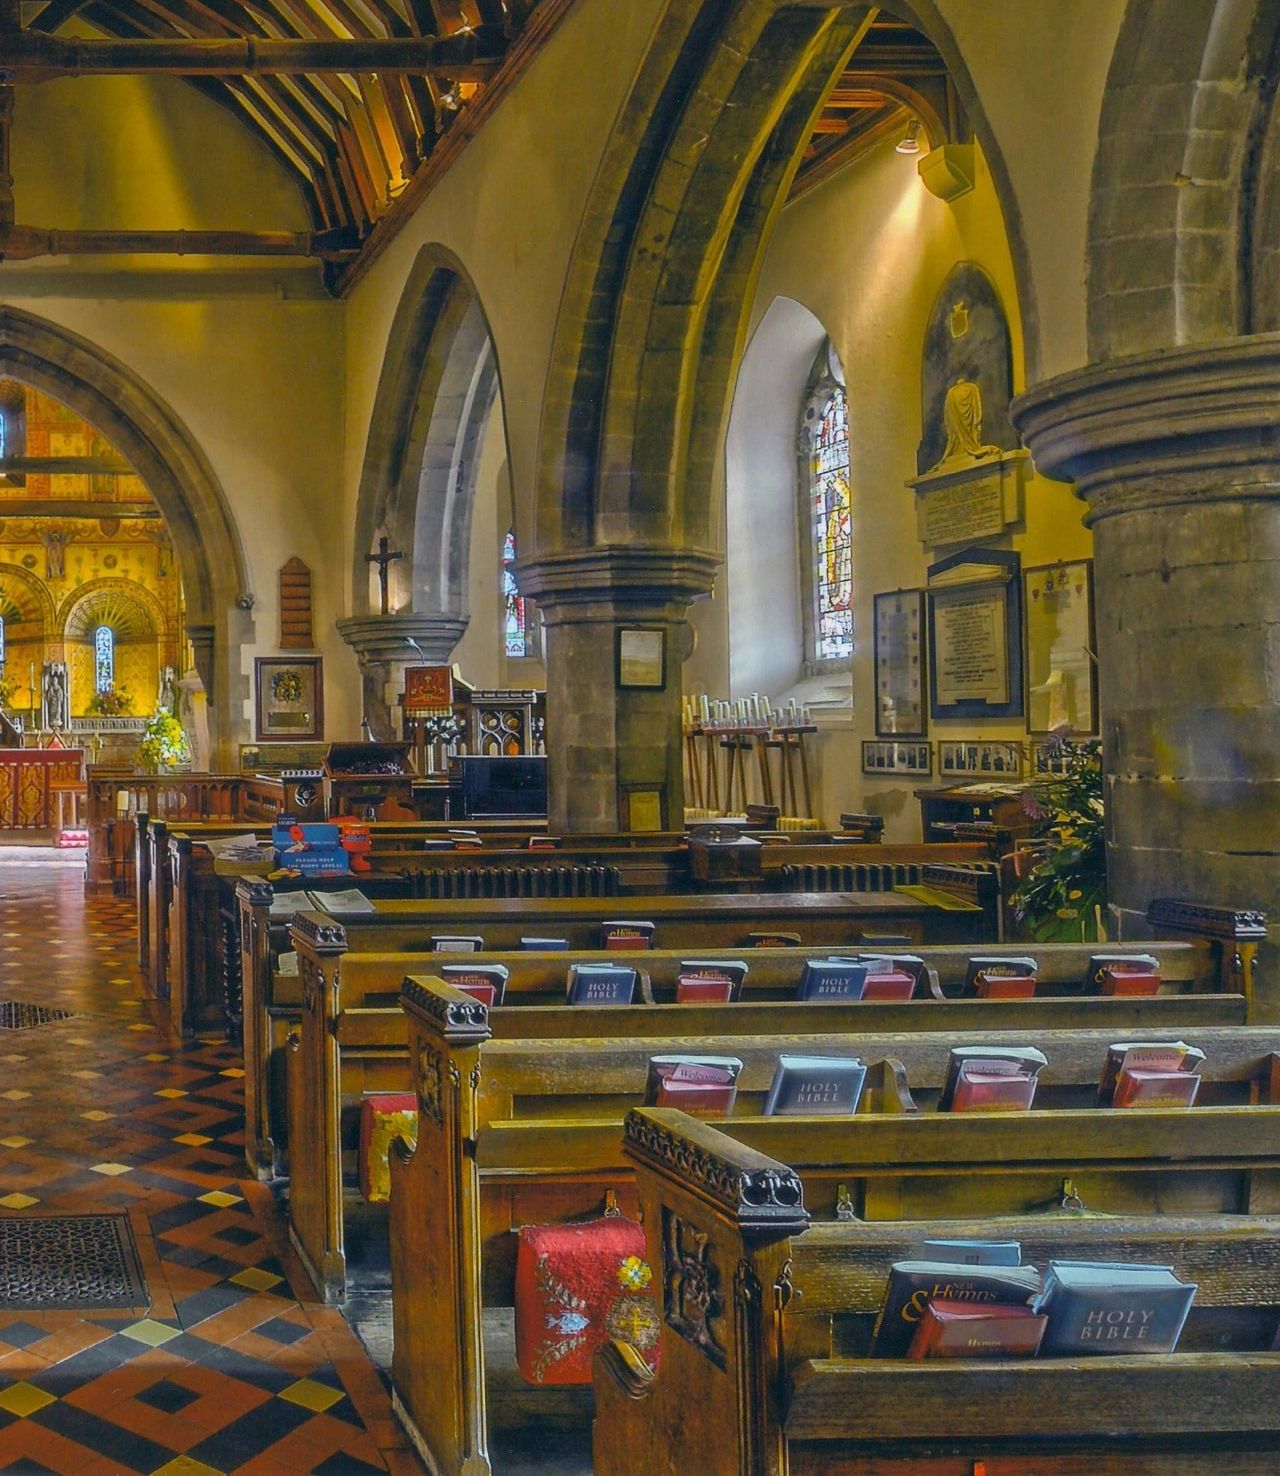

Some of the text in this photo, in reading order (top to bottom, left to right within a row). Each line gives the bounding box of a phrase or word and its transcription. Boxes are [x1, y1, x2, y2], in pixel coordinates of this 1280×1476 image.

[821, 977, 852, 986] HOLY
[588, 983, 619, 991] HOLY
[818, 986, 849, 994] BIBLE
[586, 991, 618, 999] BIBLE
[1132, 1052, 1178, 1062] Welcome
[680, 1068, 723, 1082] Welcome
[799, 1082, 842, 1093] HOLY
[797, 1093, 840, 1103] BIBLE
[931, 1284, 999, 1302] Hymns
[1086, 1310, 1156, 1325] HOLY
[1079, 1326, 1151, 1341] BIBLE
